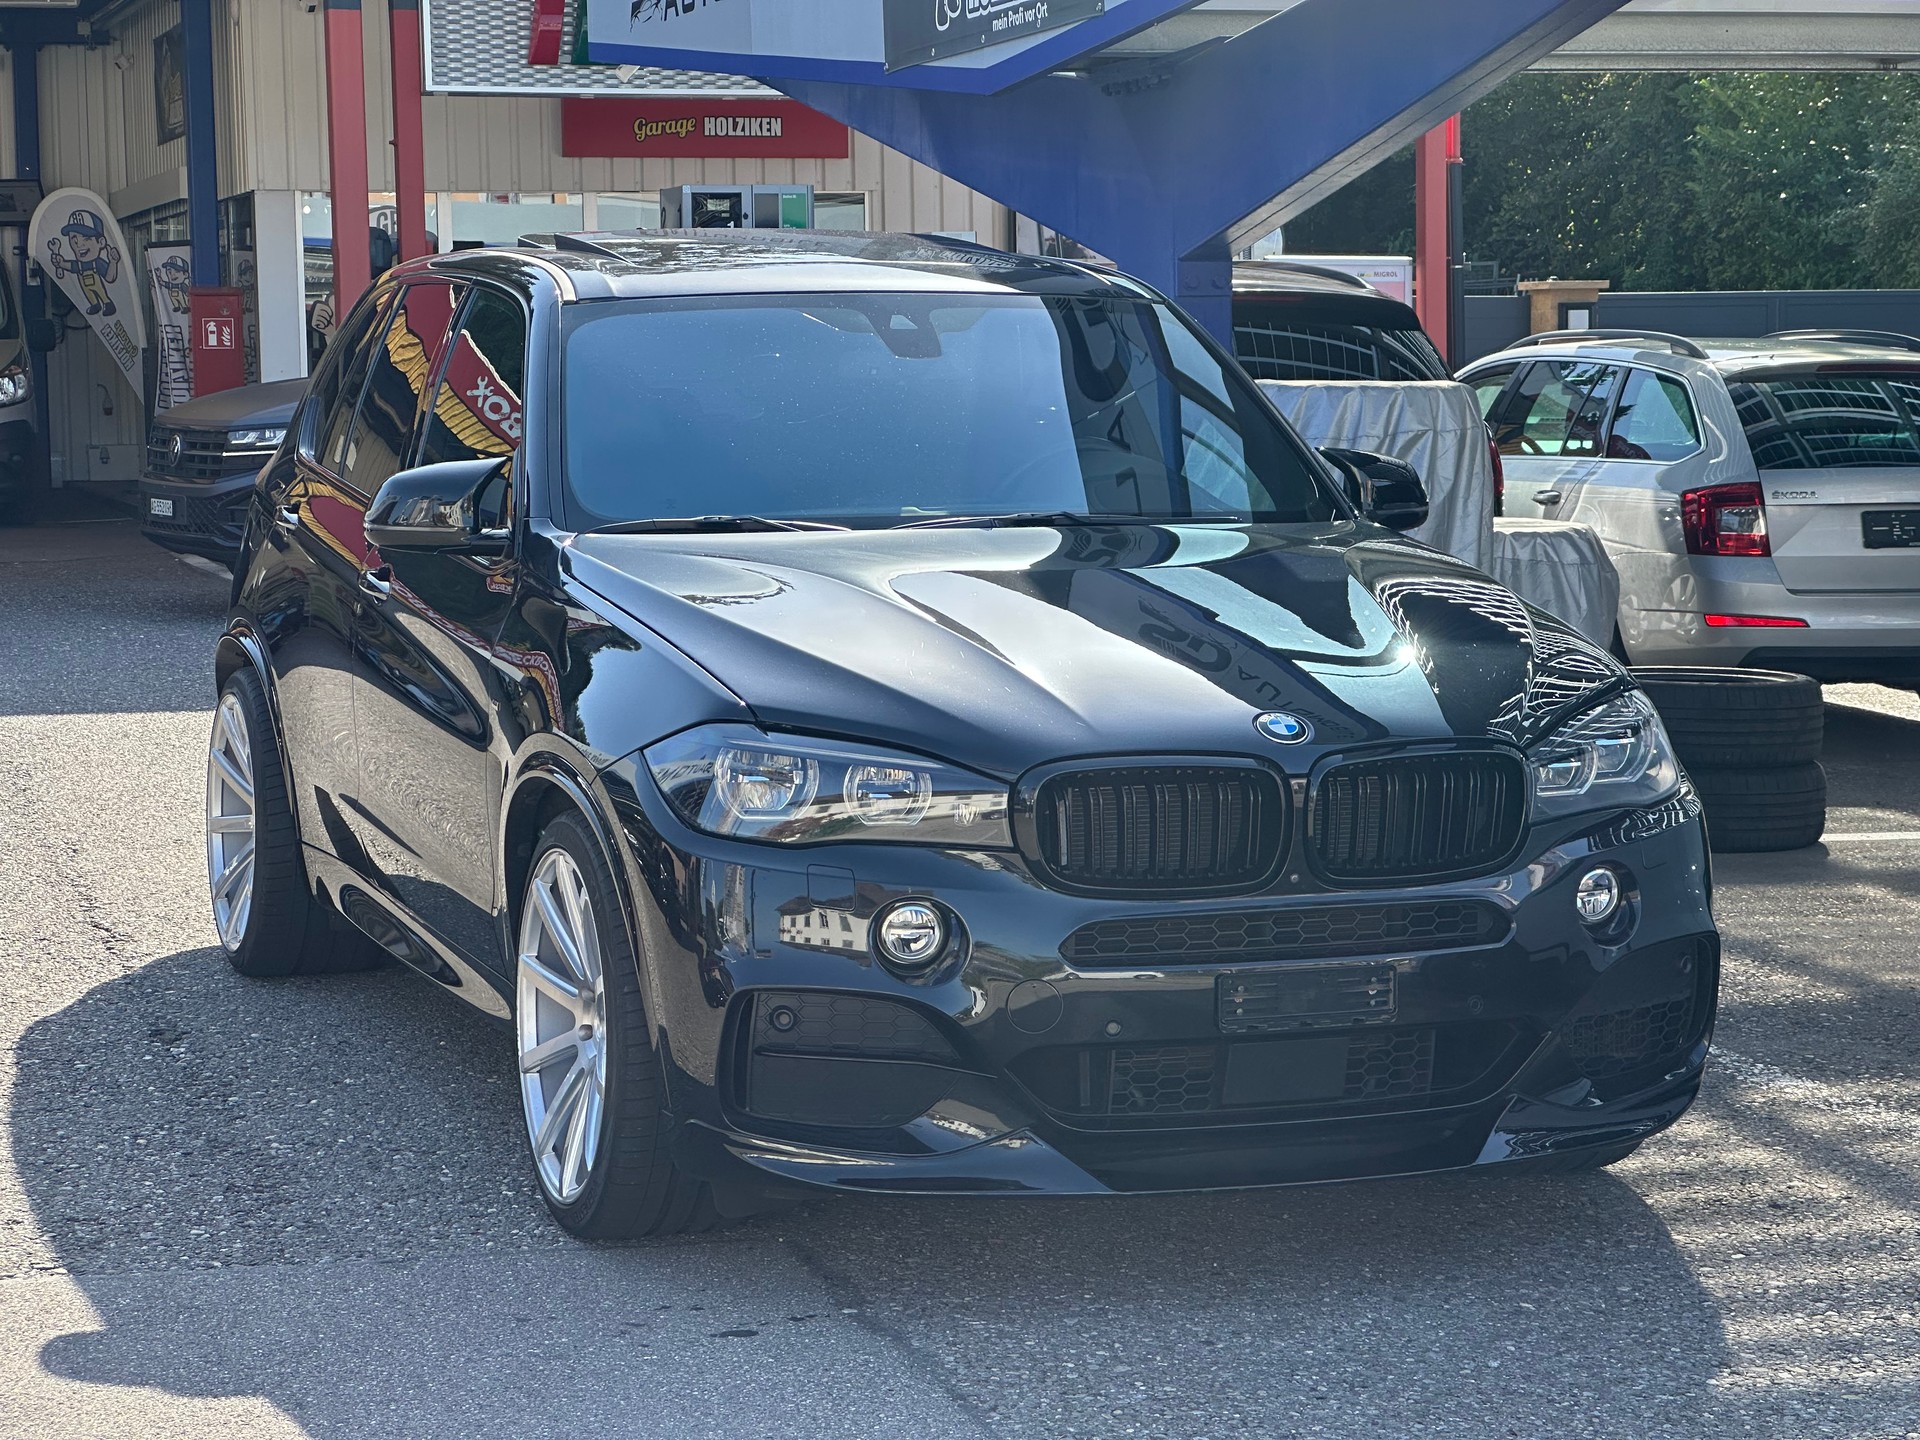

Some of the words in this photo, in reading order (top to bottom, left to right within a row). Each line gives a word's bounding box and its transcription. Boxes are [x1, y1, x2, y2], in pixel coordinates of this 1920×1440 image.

[992, 14, 1008, 31] mein
[1009, 7, 1024, 27] Profi
[1025, 9, 1035, 21] vor
[1036, 2, 1048, 20] Ort
[633, 118, 696, 142] Garage
[703, 116, 782, 137] HOLZIKEN
[1771, 489, 1819, 500] ŠKODA
